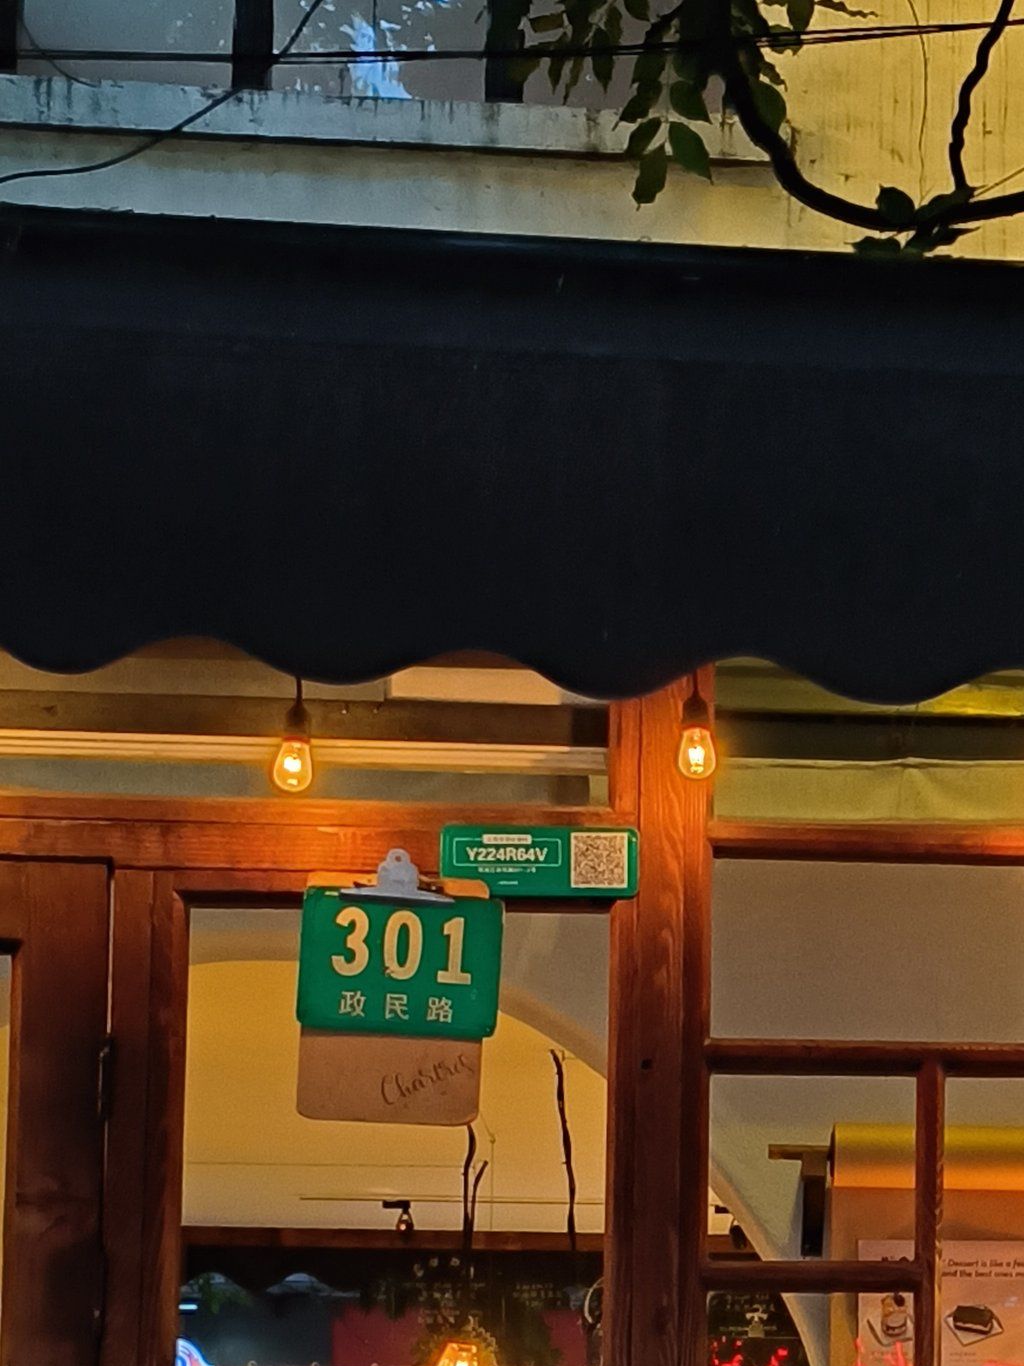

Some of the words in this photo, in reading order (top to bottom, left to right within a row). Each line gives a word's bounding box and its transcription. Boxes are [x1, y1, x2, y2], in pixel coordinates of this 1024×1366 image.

[466, 846, 548, 861] Y224R64V
[331, 906, 471, 986] 301
[338, 990, 453, 1024] 政民路
